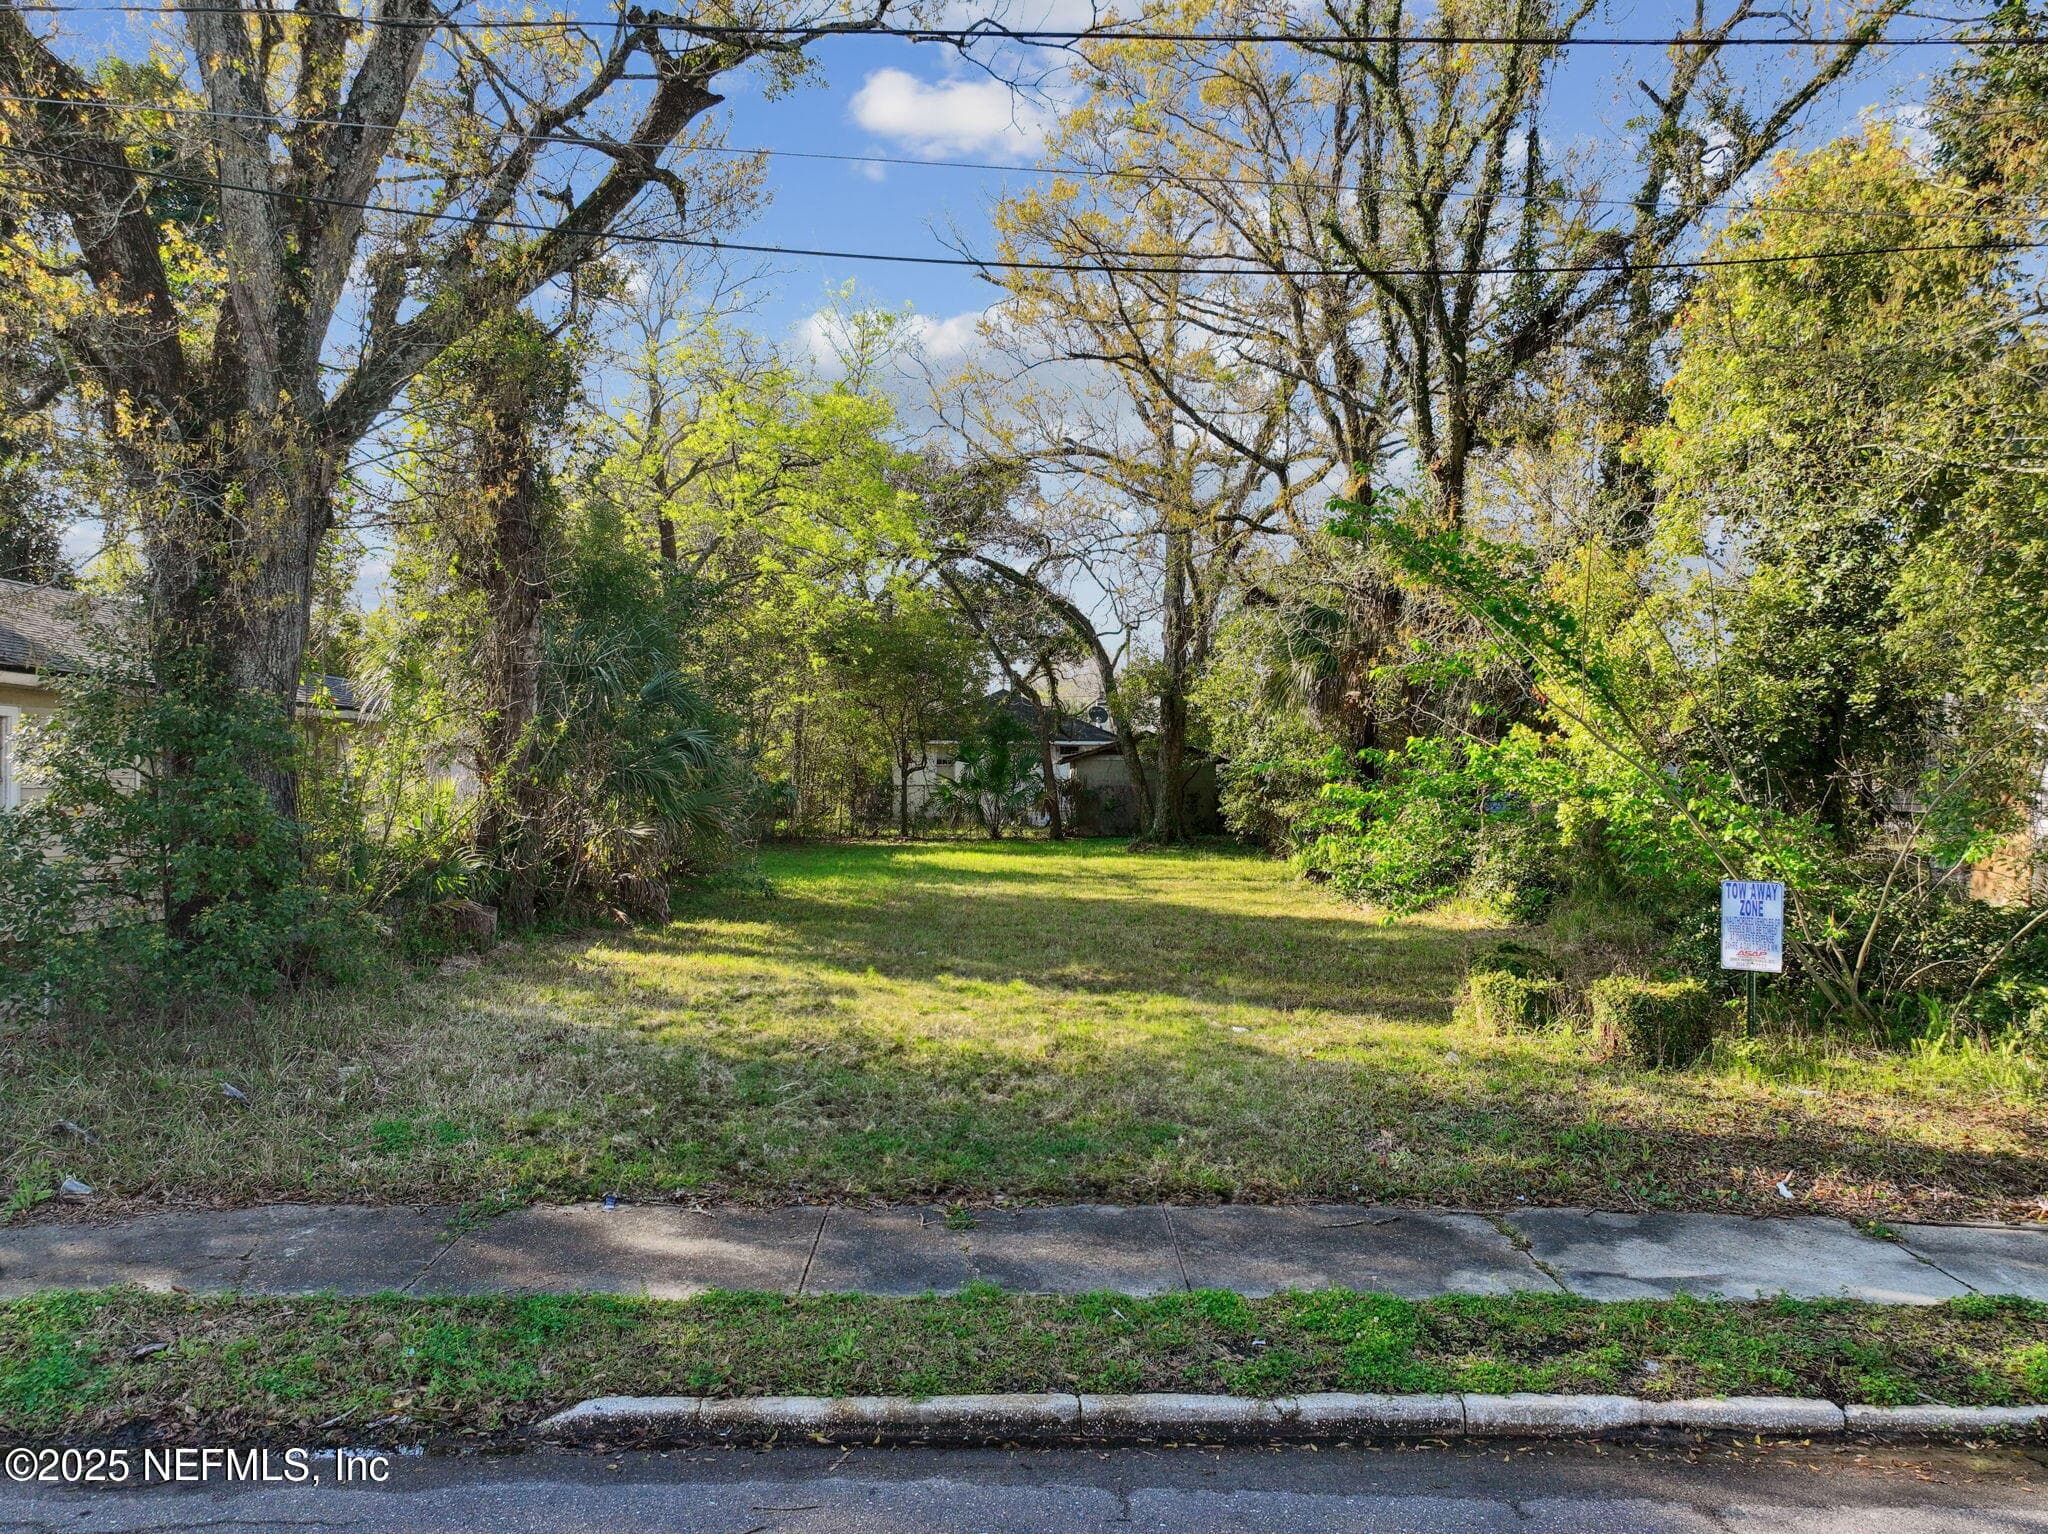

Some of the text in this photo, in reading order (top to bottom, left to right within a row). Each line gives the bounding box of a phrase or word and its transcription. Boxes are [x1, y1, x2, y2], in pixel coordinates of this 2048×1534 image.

[1726, 882, 1778, 901] TOW AWAY
[1740, 900, 1764, 916] ZONE
